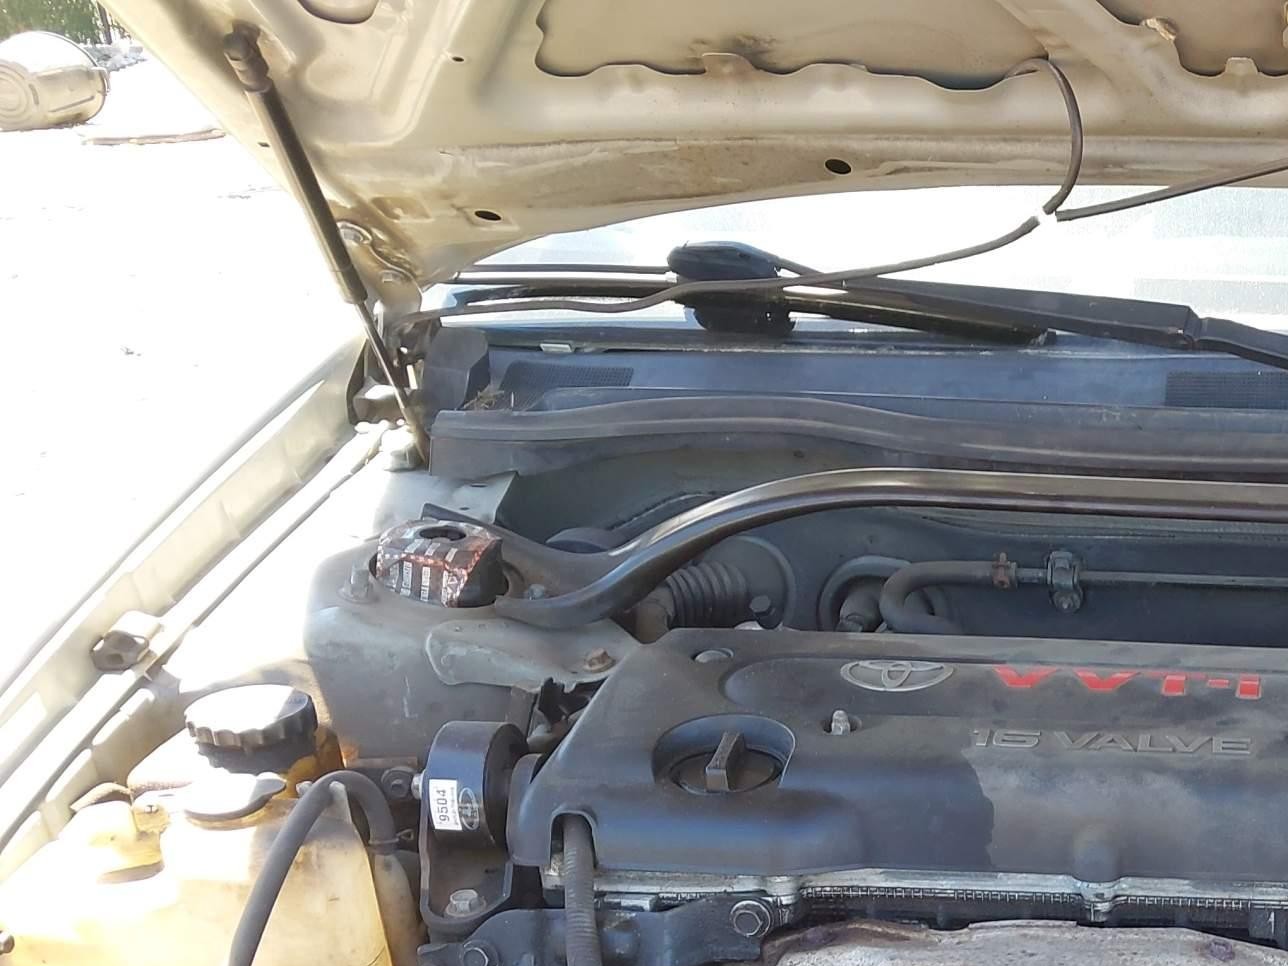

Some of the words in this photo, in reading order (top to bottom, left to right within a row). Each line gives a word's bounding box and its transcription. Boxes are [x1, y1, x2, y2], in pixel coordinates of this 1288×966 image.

[973, 729, 1041, 747] 16
[1054, 731, 1251, 754] VALVE
[436, 789, 450, 822] 9504
